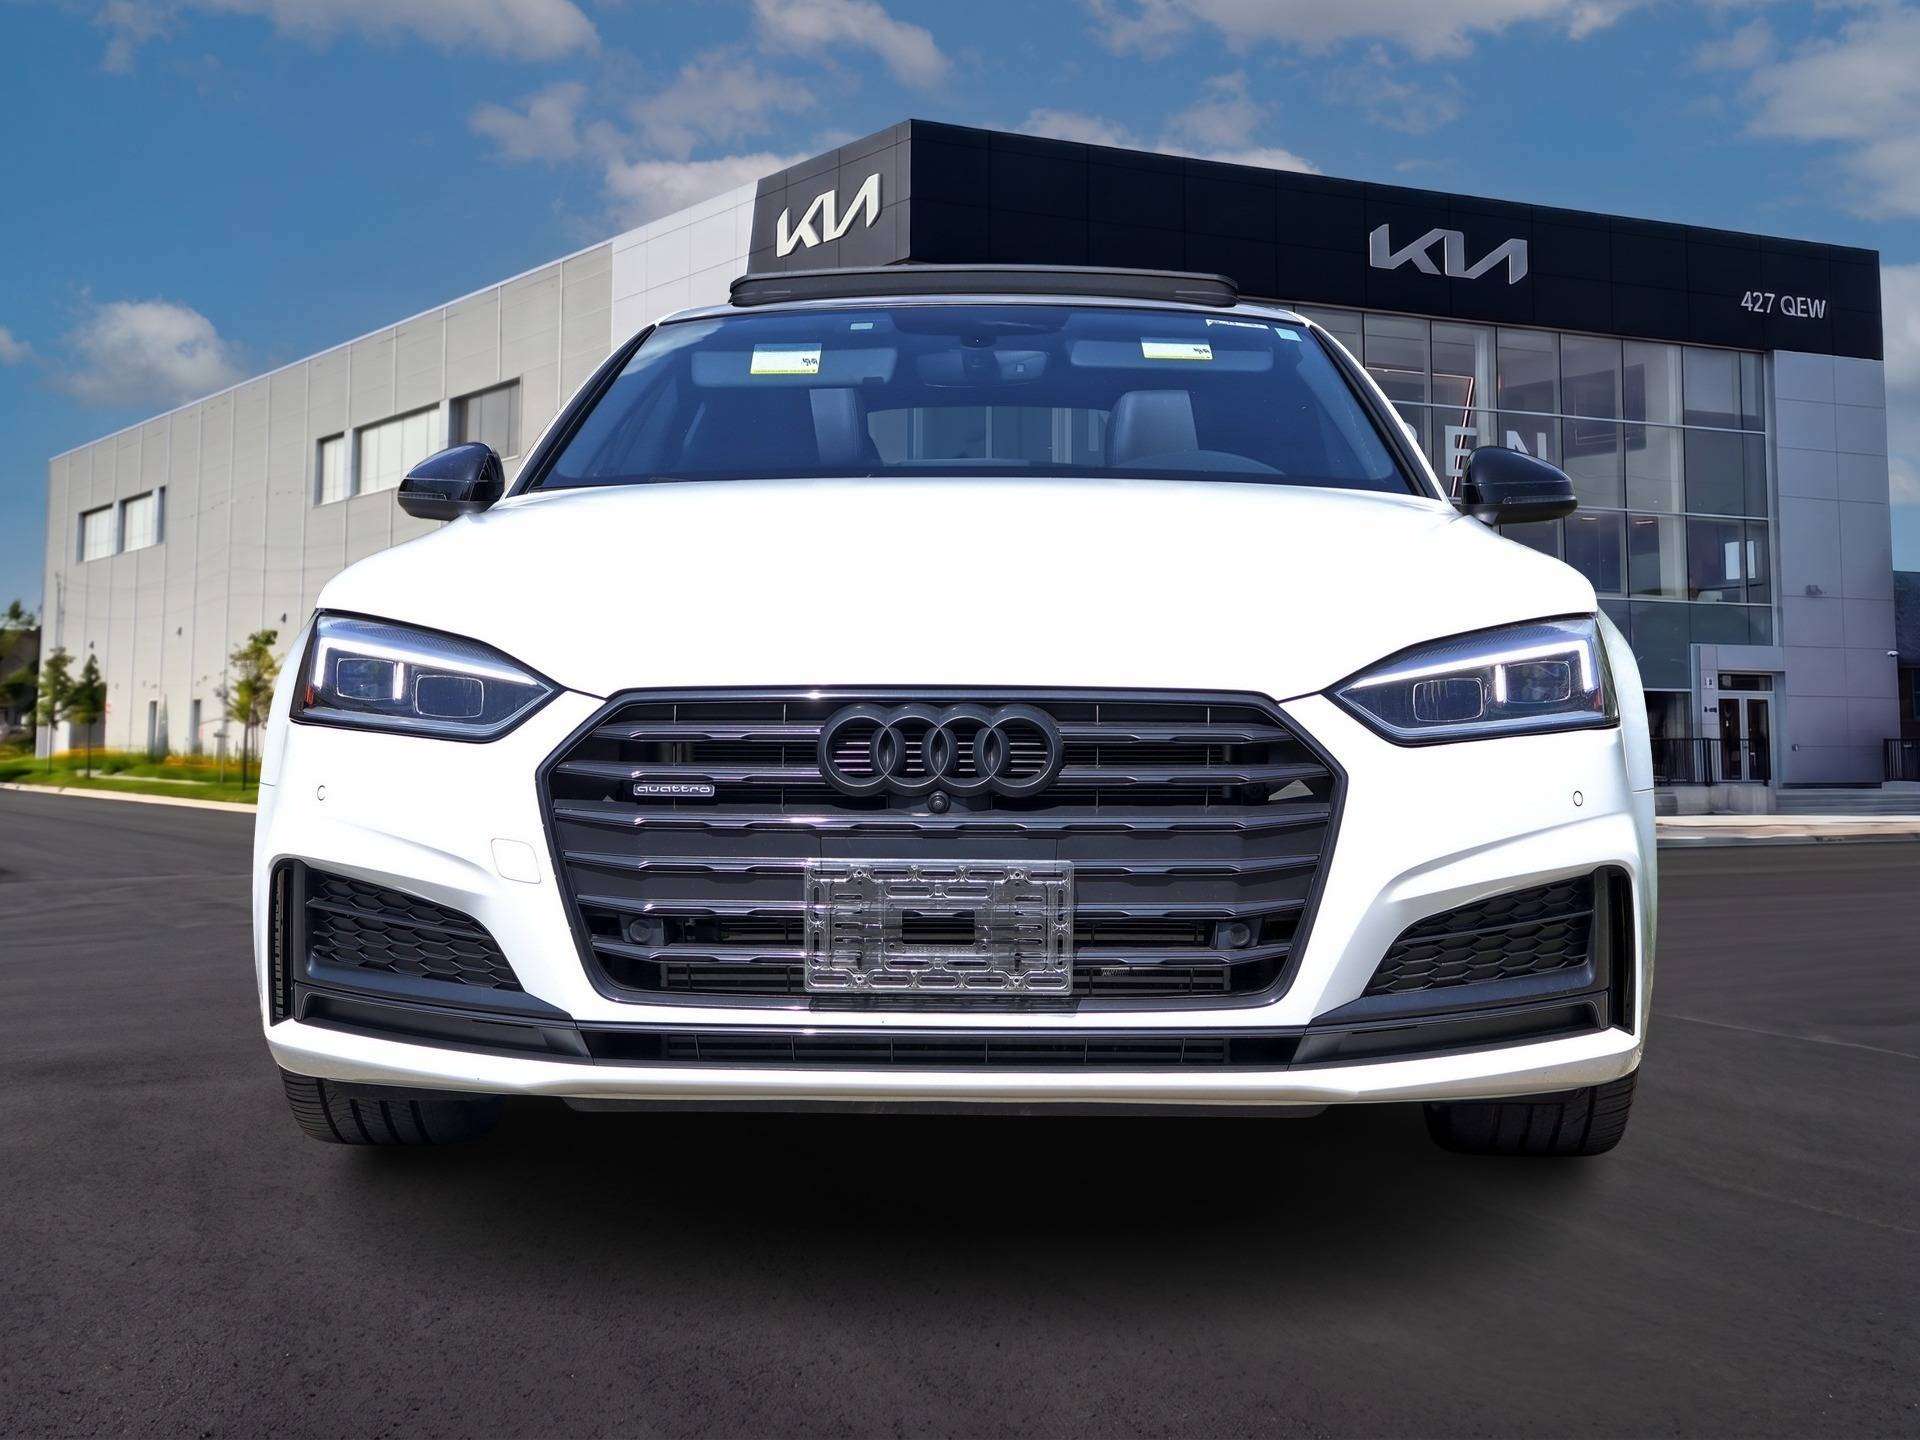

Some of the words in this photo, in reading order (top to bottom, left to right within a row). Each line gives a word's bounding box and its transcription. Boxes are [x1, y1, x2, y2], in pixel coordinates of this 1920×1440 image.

[776, 173, 881, 258] KIA
[1369, 223, 1528, 285] KIA
[1741, 291, 1776, 313] 427
[1781, 295, 1826, 318] QEW
[637, 784, 711, 793] quattro
